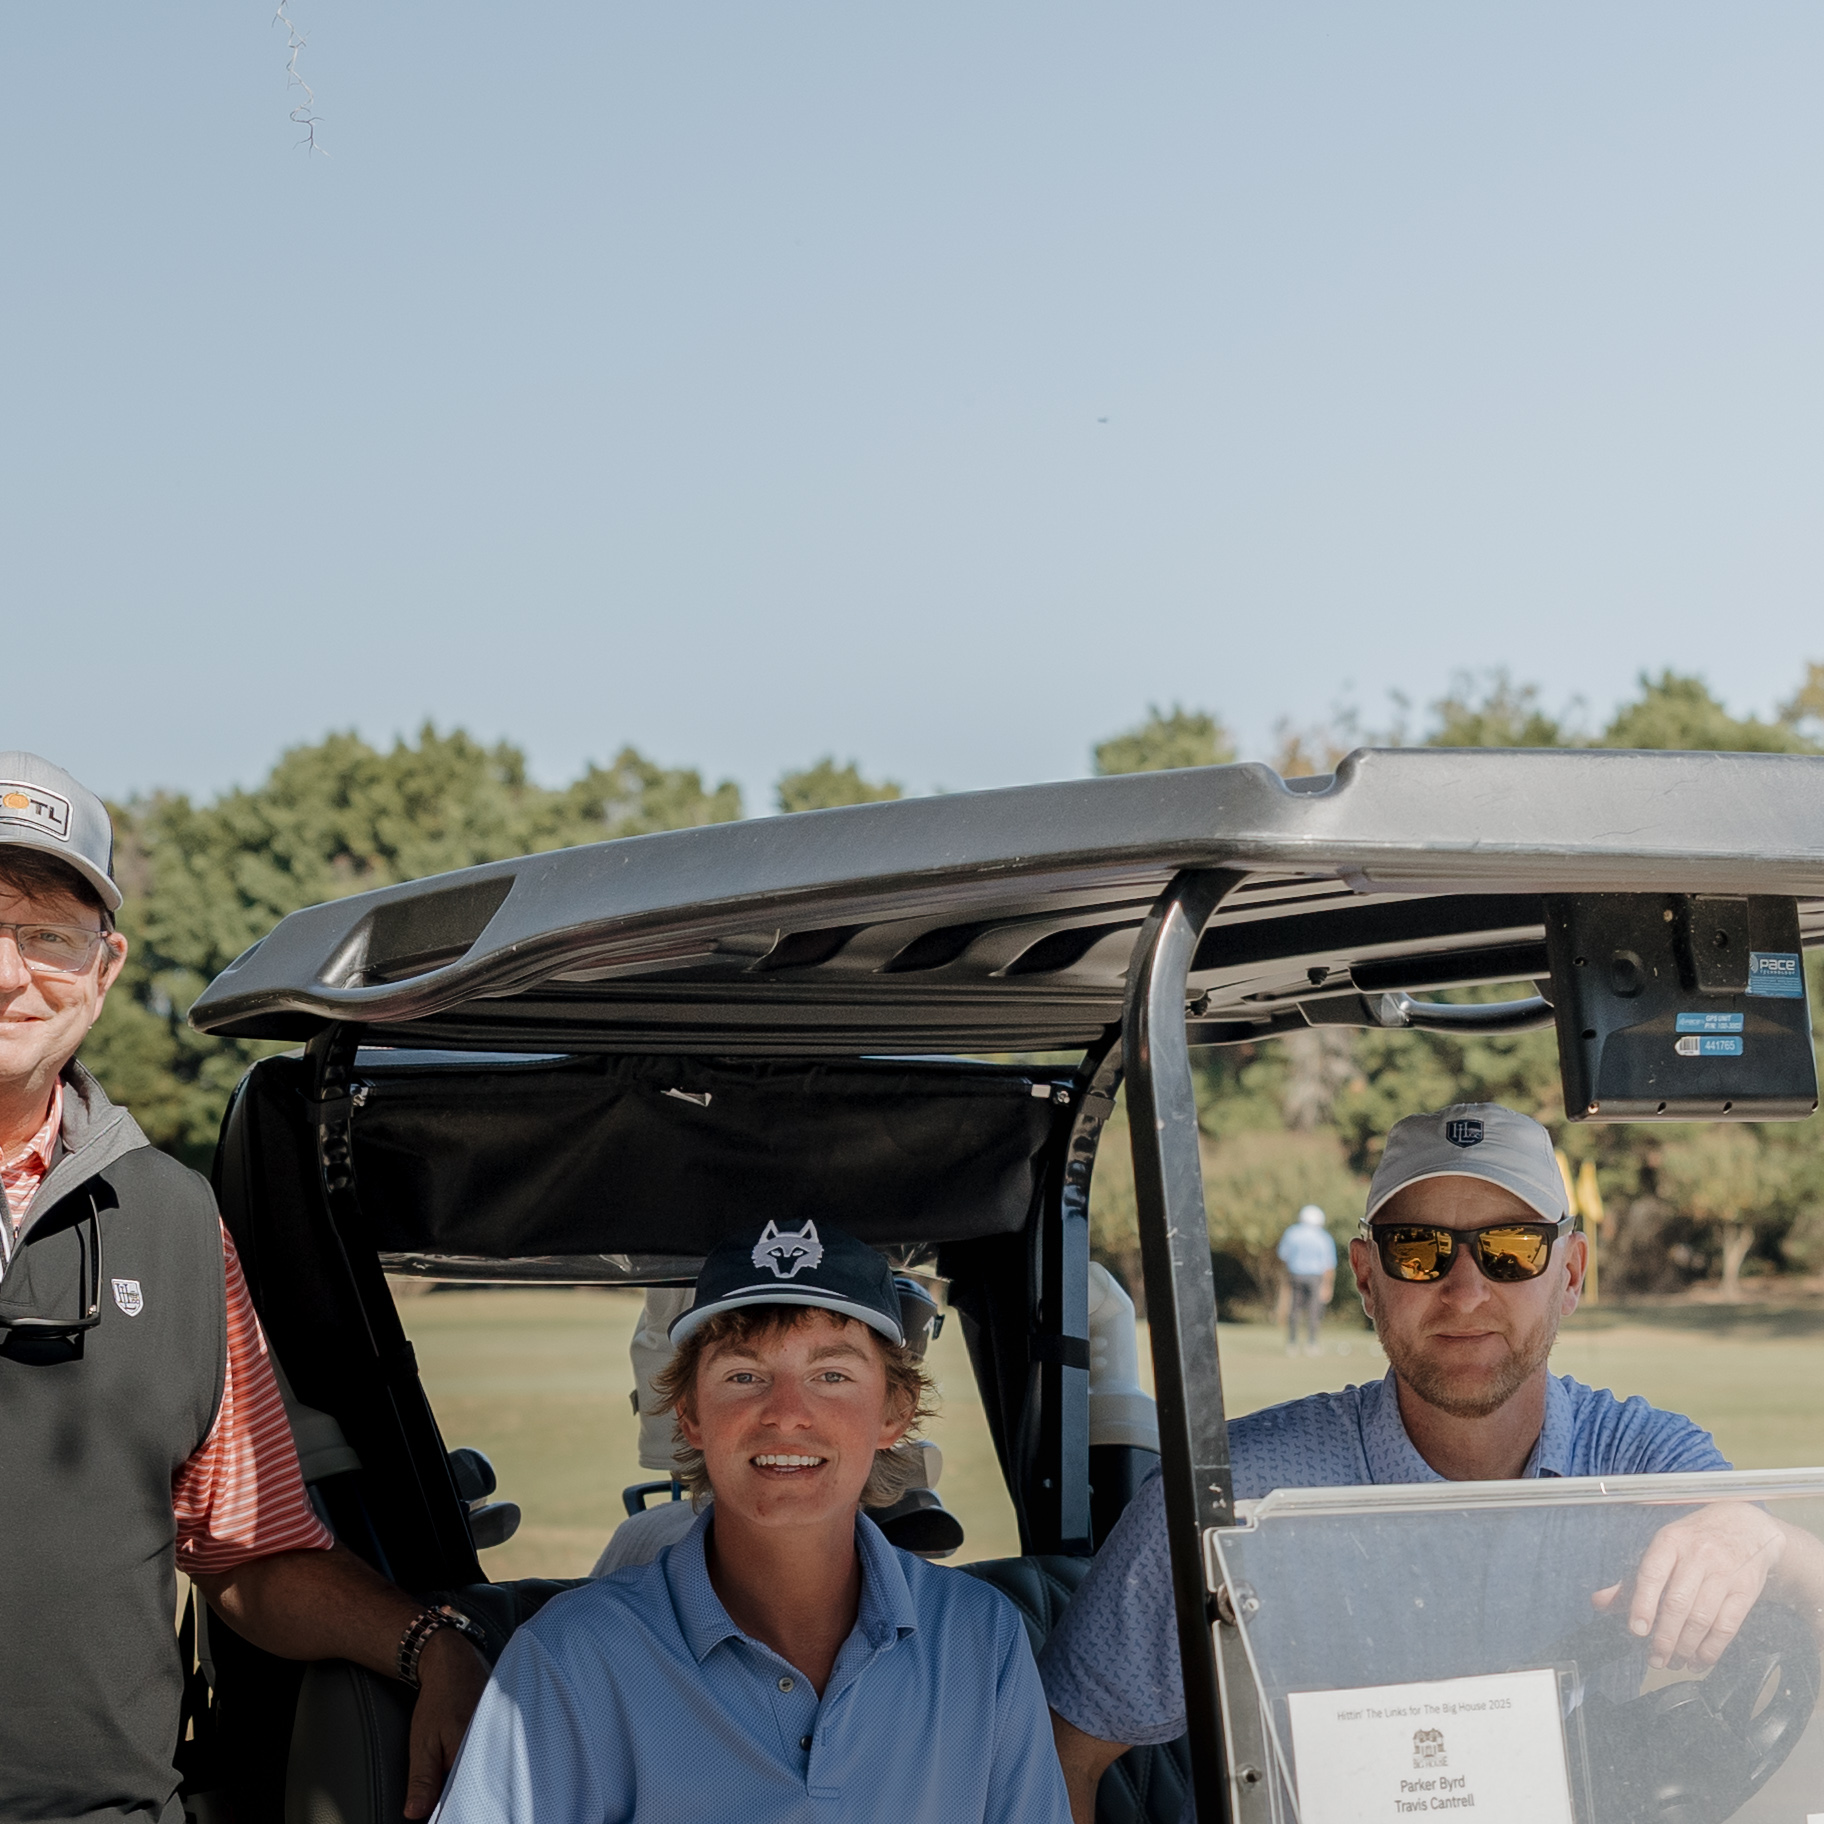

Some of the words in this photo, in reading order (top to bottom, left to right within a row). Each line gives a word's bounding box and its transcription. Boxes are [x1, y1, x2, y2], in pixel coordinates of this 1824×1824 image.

[1704, 1040, 1736, 1050] 441765
[1337, 1710, 1363, 1721] Hittin'
[1366, 1708, 1383, 1719] The
[1385, 1706, 1407, 1718] Links
[1409, 1705, 1421, 1716] for
[1423, 1703, 1441, 1714] The
[1442, 1702, 1457, 1715] Big
[1458, 1700, 1487, 1712] House
[1488, 1698, 1512, 1710] 2025
[1400, 1778, 1437, 1793] Parker
[1439, 1775, 1466, 1792] Byrd
[1394, 1797, 1428, 1813] Travis
[1430, 1793, 1475, 1811] Cantrell
